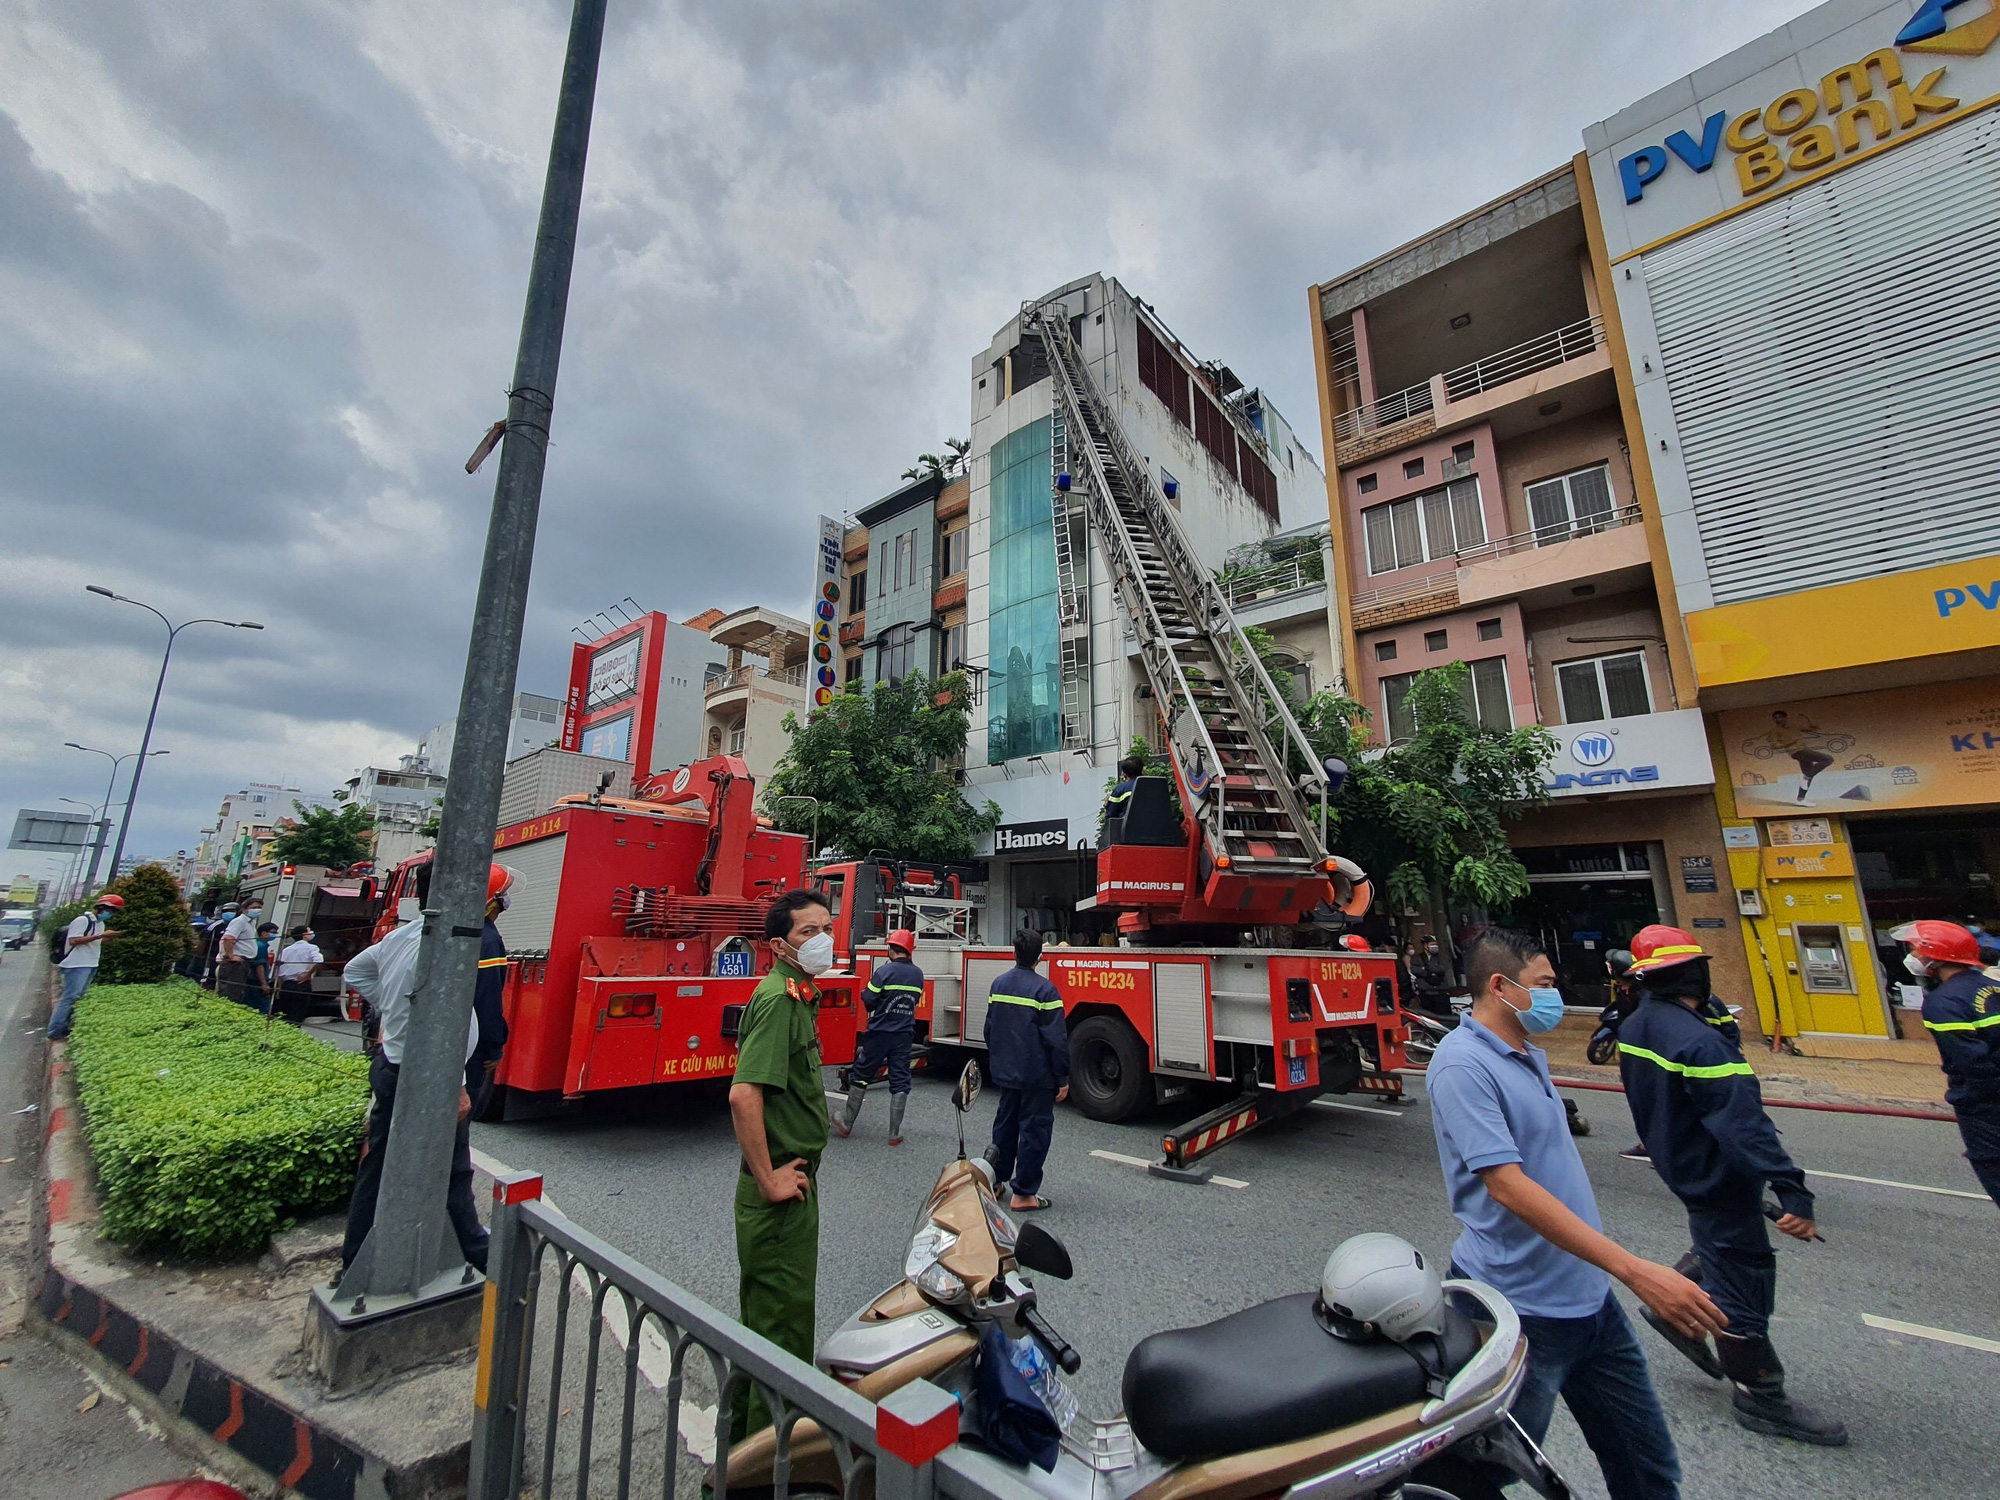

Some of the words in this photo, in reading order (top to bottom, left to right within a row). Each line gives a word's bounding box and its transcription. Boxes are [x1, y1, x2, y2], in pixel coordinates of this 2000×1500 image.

[1734, 66, 1960, 197] Bank
[541, 816, 561, 835] 114
[996, 830, 1066, 849] Hames
[1124, 881, 1170, 891] MAGIRUS
[966, 890, 986, 904] Hames
[724, 954, 742, 965] 51A
[1077, 960, 1110, 968] MAGIRUS
[721, 965, 744, 975] 4581
[1321, 962, 1362, 981] 51F-0234
[1068, 970, 1135, 990] 51F-0234
[663, 1059, 677, 1075] XE
[681, 1053, 703, 1073] CỨU
[705, 1055, 725, 1074] NẠN
[1291, 1069, 1306, 1083] 0234
